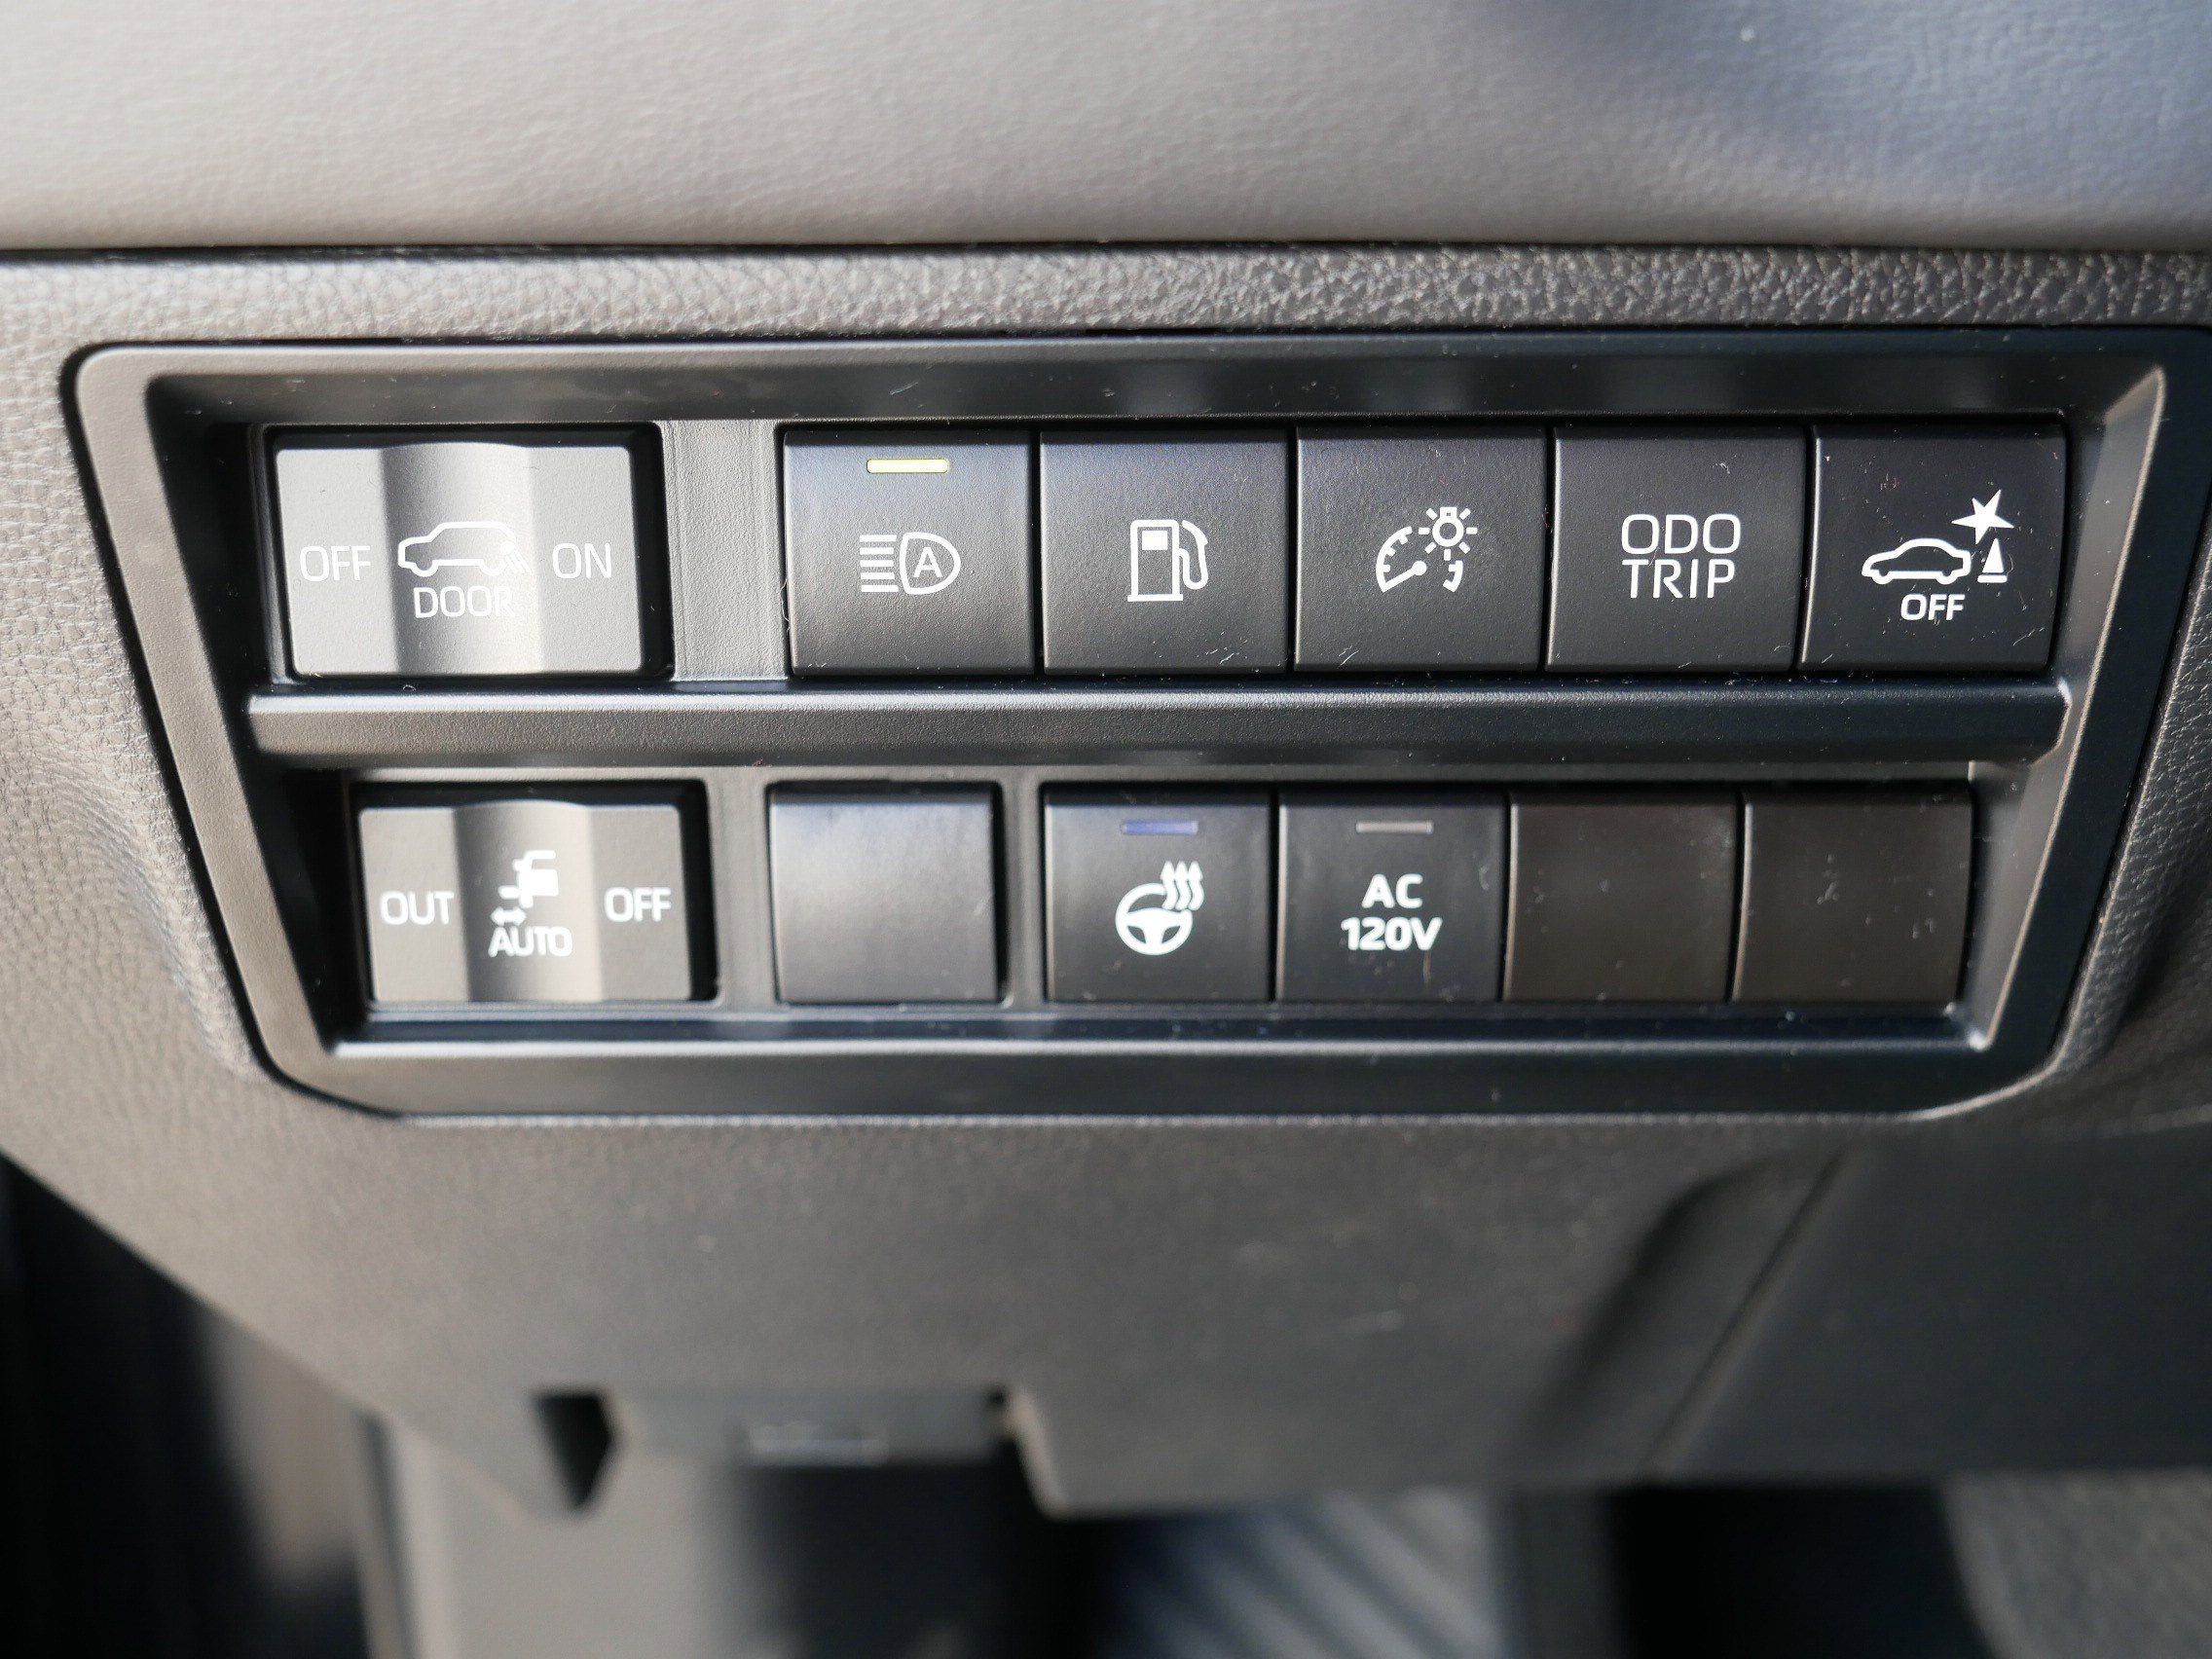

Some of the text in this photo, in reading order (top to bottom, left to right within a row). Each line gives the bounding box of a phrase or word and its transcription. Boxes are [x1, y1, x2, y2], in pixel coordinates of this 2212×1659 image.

[1621, 513, 1742, 555] ODO
[299, 545, 371, 581] OFF
[552, 543, 612, 579] ON
[1621, 559, 1736, 599] TRIP
[413, 585, 516, 618] DOOR
[1899, 593, 1966, 621] OFF
[380, 890, 455, 925] OUT
[605, 887, 672, 922] OFF
[1361, 873, 1423, 908] AC
[488, 926, 573, 958] AUTO
[1340, 916, 1443, 951] 120V
